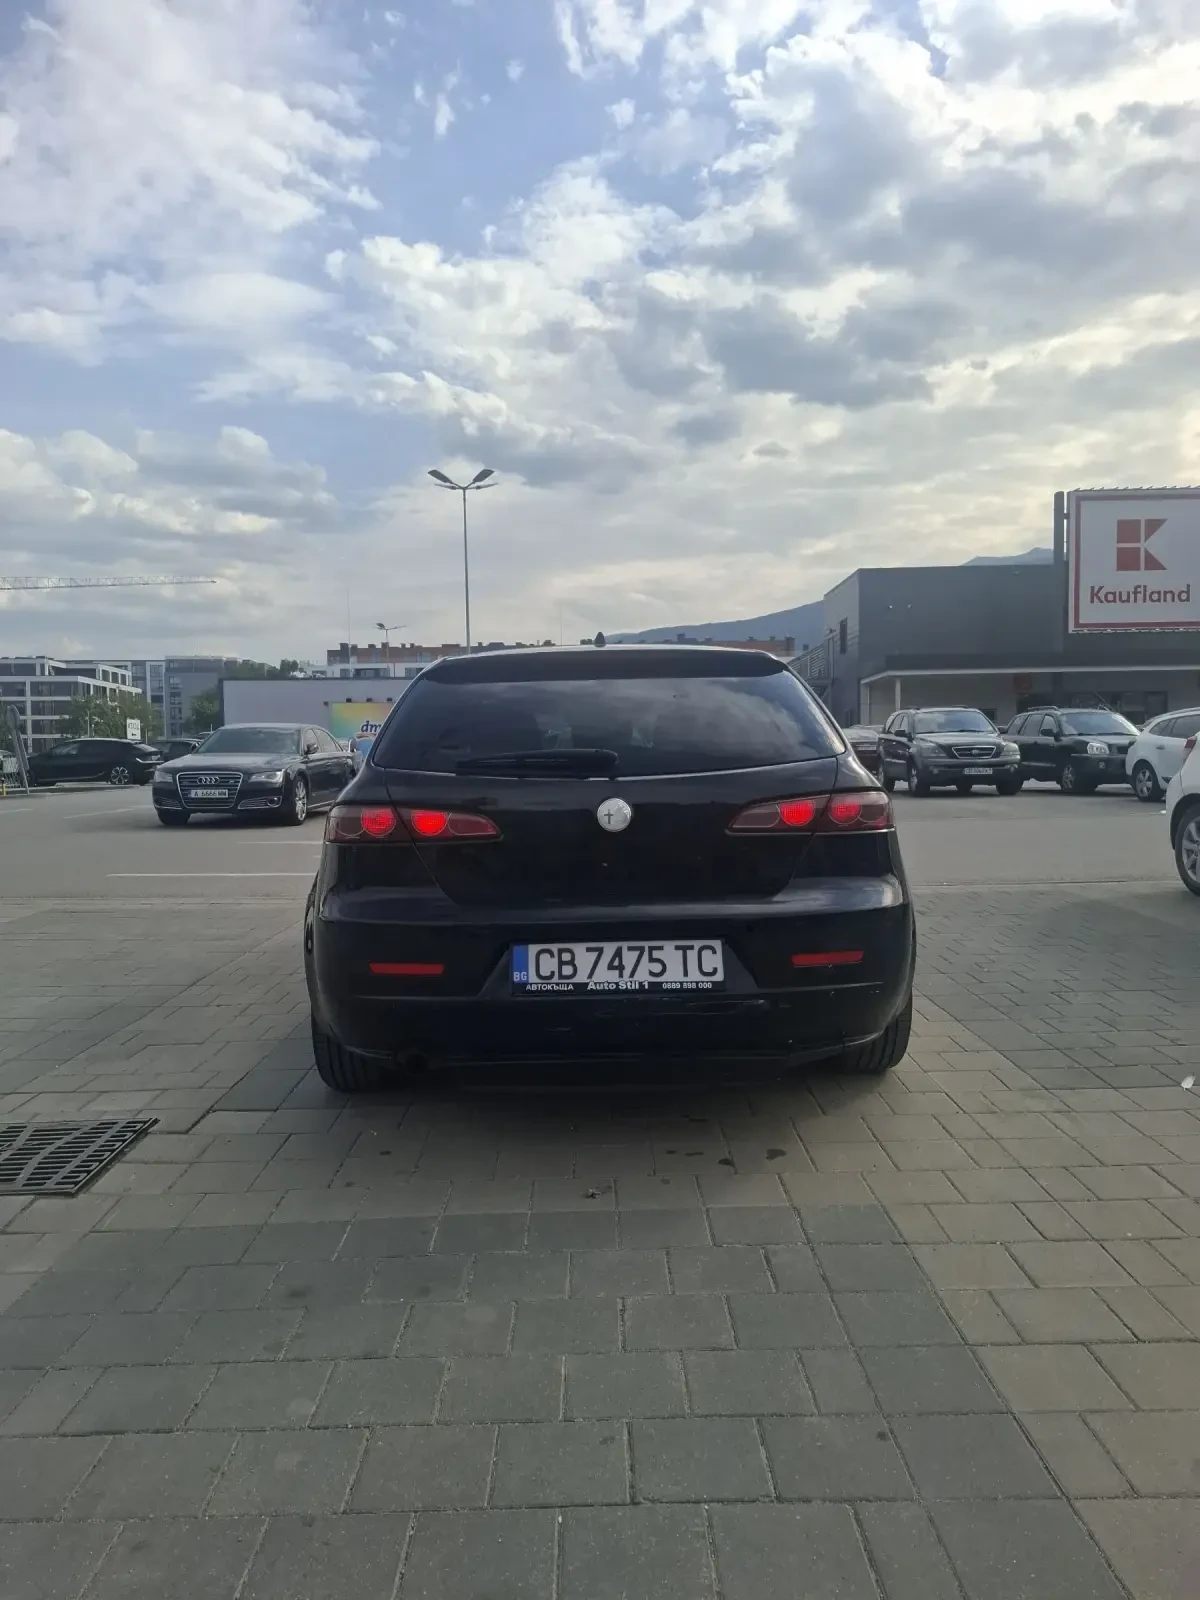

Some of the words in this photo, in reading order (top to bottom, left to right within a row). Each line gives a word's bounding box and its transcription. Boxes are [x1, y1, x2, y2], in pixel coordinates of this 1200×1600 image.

[1089, 584, 1191, 604] Kaufland
[361, 720, 381, 732] dm
[534, 947, 578, 981] CB
[585, 945, 667, 980] 7475
[674, 944, 718, 977] TC
[513, 971, 528, 982] BG
[525, 983, 574, 991] АВТОКЪЩА
[587, 981, 617, 990] Auto
[619, 980, 639, 990] Stil
[642, 981, 649, 989] 1
